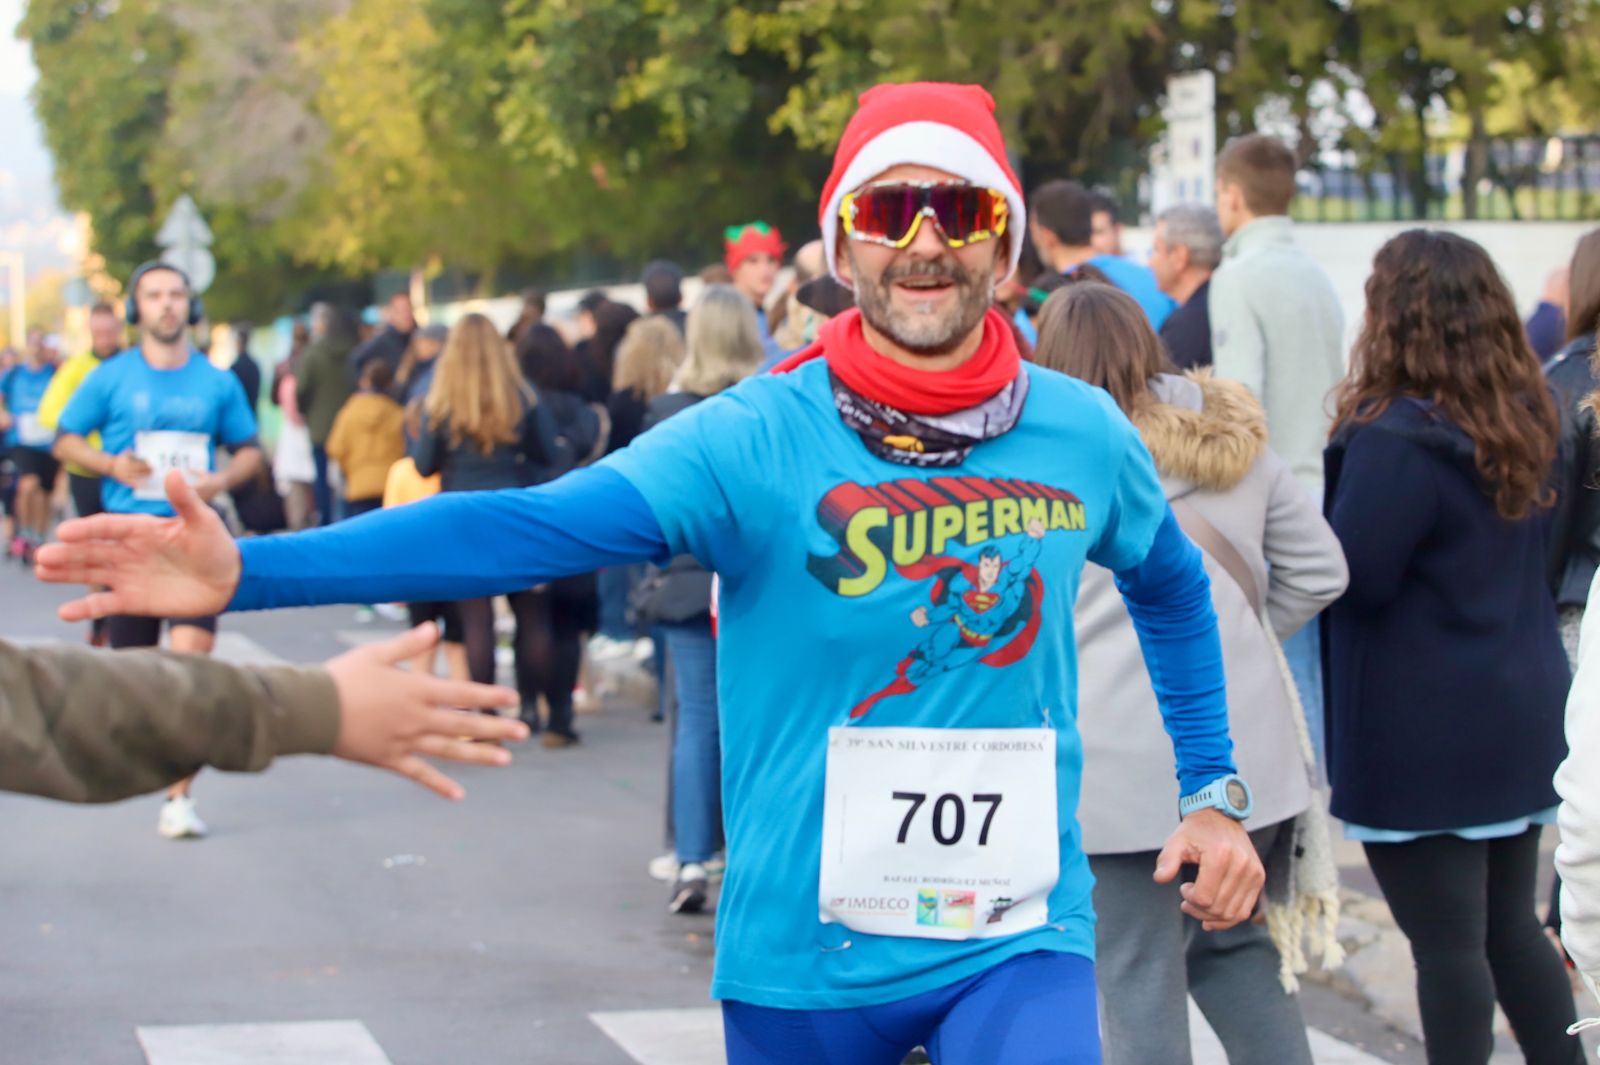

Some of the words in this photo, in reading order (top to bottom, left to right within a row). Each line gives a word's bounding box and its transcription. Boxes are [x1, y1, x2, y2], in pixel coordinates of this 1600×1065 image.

[836, 492, 1087, 597] SUPERMAN
[868, 738, 894, 749] SAN
[898, 740, 968, 752] SILVESTRE
[892, 791, 1003, 846] 707
[847, 897, 910, 911] IMDECO
